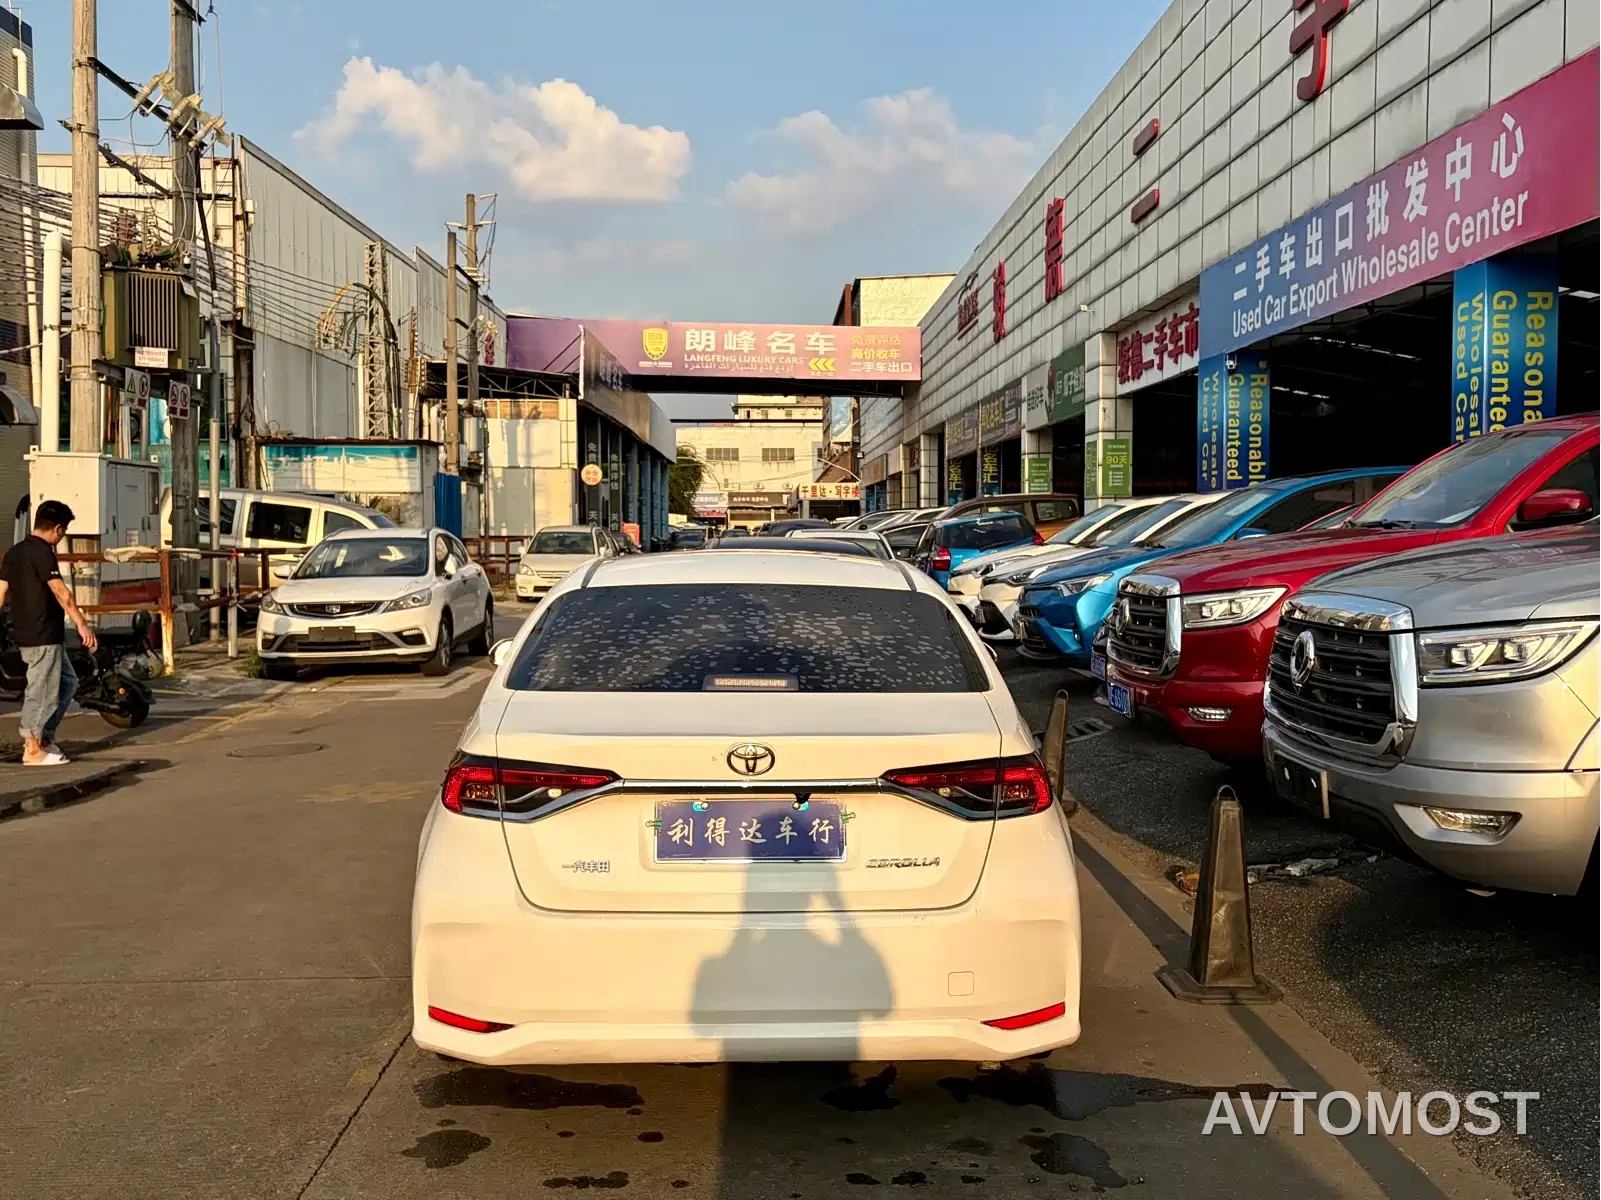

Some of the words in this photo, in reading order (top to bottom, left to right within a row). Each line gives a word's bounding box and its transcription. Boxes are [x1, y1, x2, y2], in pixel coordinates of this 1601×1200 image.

[1233, 112, 1525, 301] 二手车出口批发中心
[1233, 305, 1262, 338] Used
[1264, 296, 1286, 323] Car
[1289, 268, 1338, 317] Export
[1342, 226, 1438, 293] Wholesale
[1444, 190, 1529, 254] Center
[684, 328, 837, 355] 朗峰名车
[684, 354, 737, 363] LANGFENG
[738, 355, 777, 364] LUXURY
[779, 356, 804, 365] CARS
[851, 348, 901, 360] 高价收车
[1456, 301, 1470, 380] Used
[849, 361, 913, 373] 二手车出口
[1210, 371, 1220, 489] Wholesale
[1226, 373, 1245, 480] Guaranteed
[1455, 392, 1468, 443] Car
[610, 453, 619, 491] 免费评估
[1201, 442, 1209, 482] Car
[667, 816, 835, 847] 利得达车行
[561, 860, 611, 873] 一汽丰田
[865, 856, 940, 869] COROLLA
